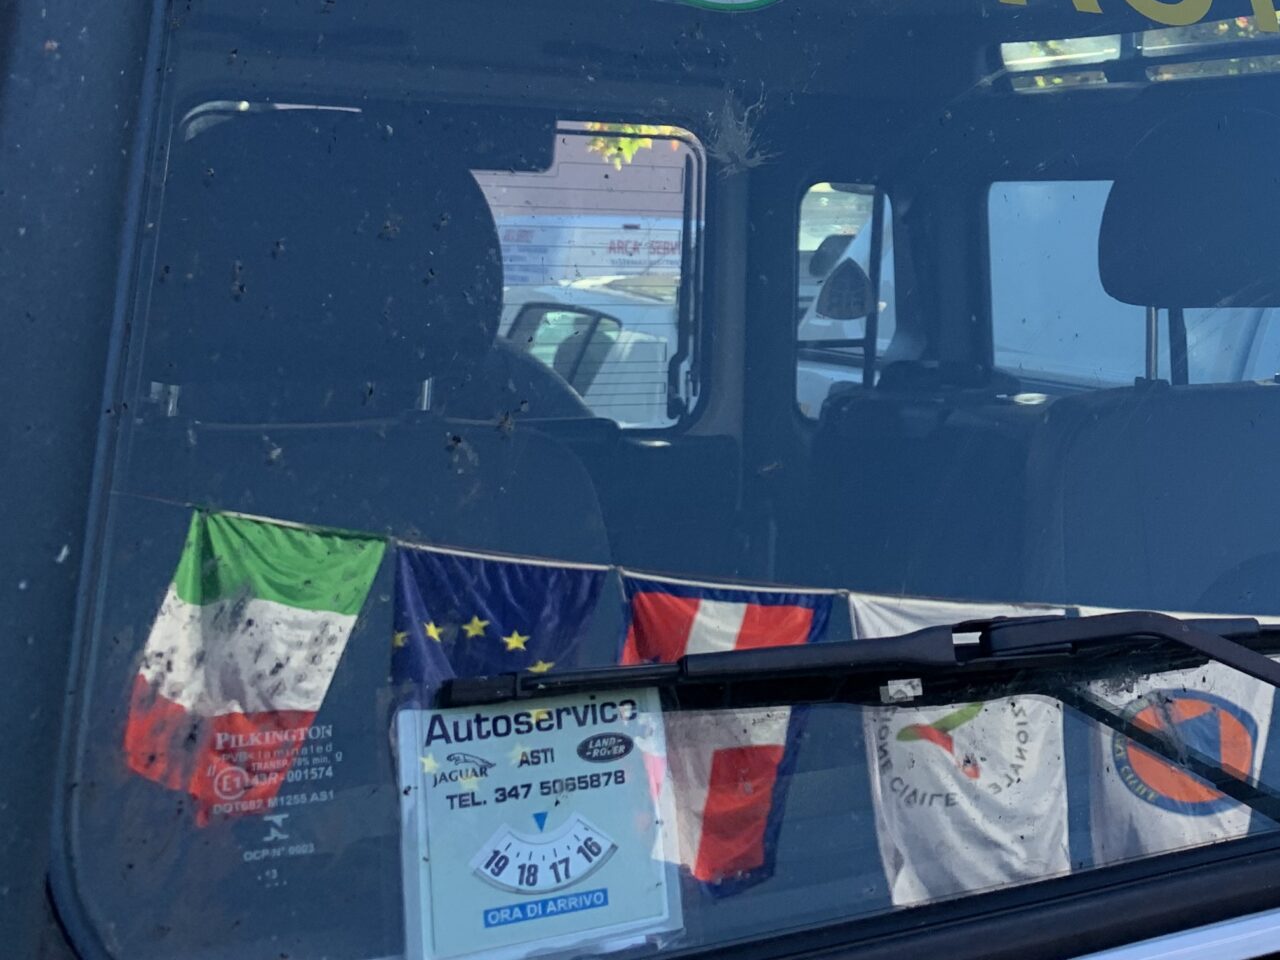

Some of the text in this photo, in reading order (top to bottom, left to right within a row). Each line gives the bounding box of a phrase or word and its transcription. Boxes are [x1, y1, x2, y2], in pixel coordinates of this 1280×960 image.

[425, 695, 638, 747] Autoservice
[215, 725, 333, 750] PILKINGTON
[517, 748, 555, 768] ASTI
[221, 774, 242, 792] E1
[432, 766, 489, 788] JAGUAR
[446, 770, 626, 810] TEL. 347 5065878
[484, 837, 602, 886] 19 18 17 16
[487, 891, 604, 925] ORA DI ARRIVO
